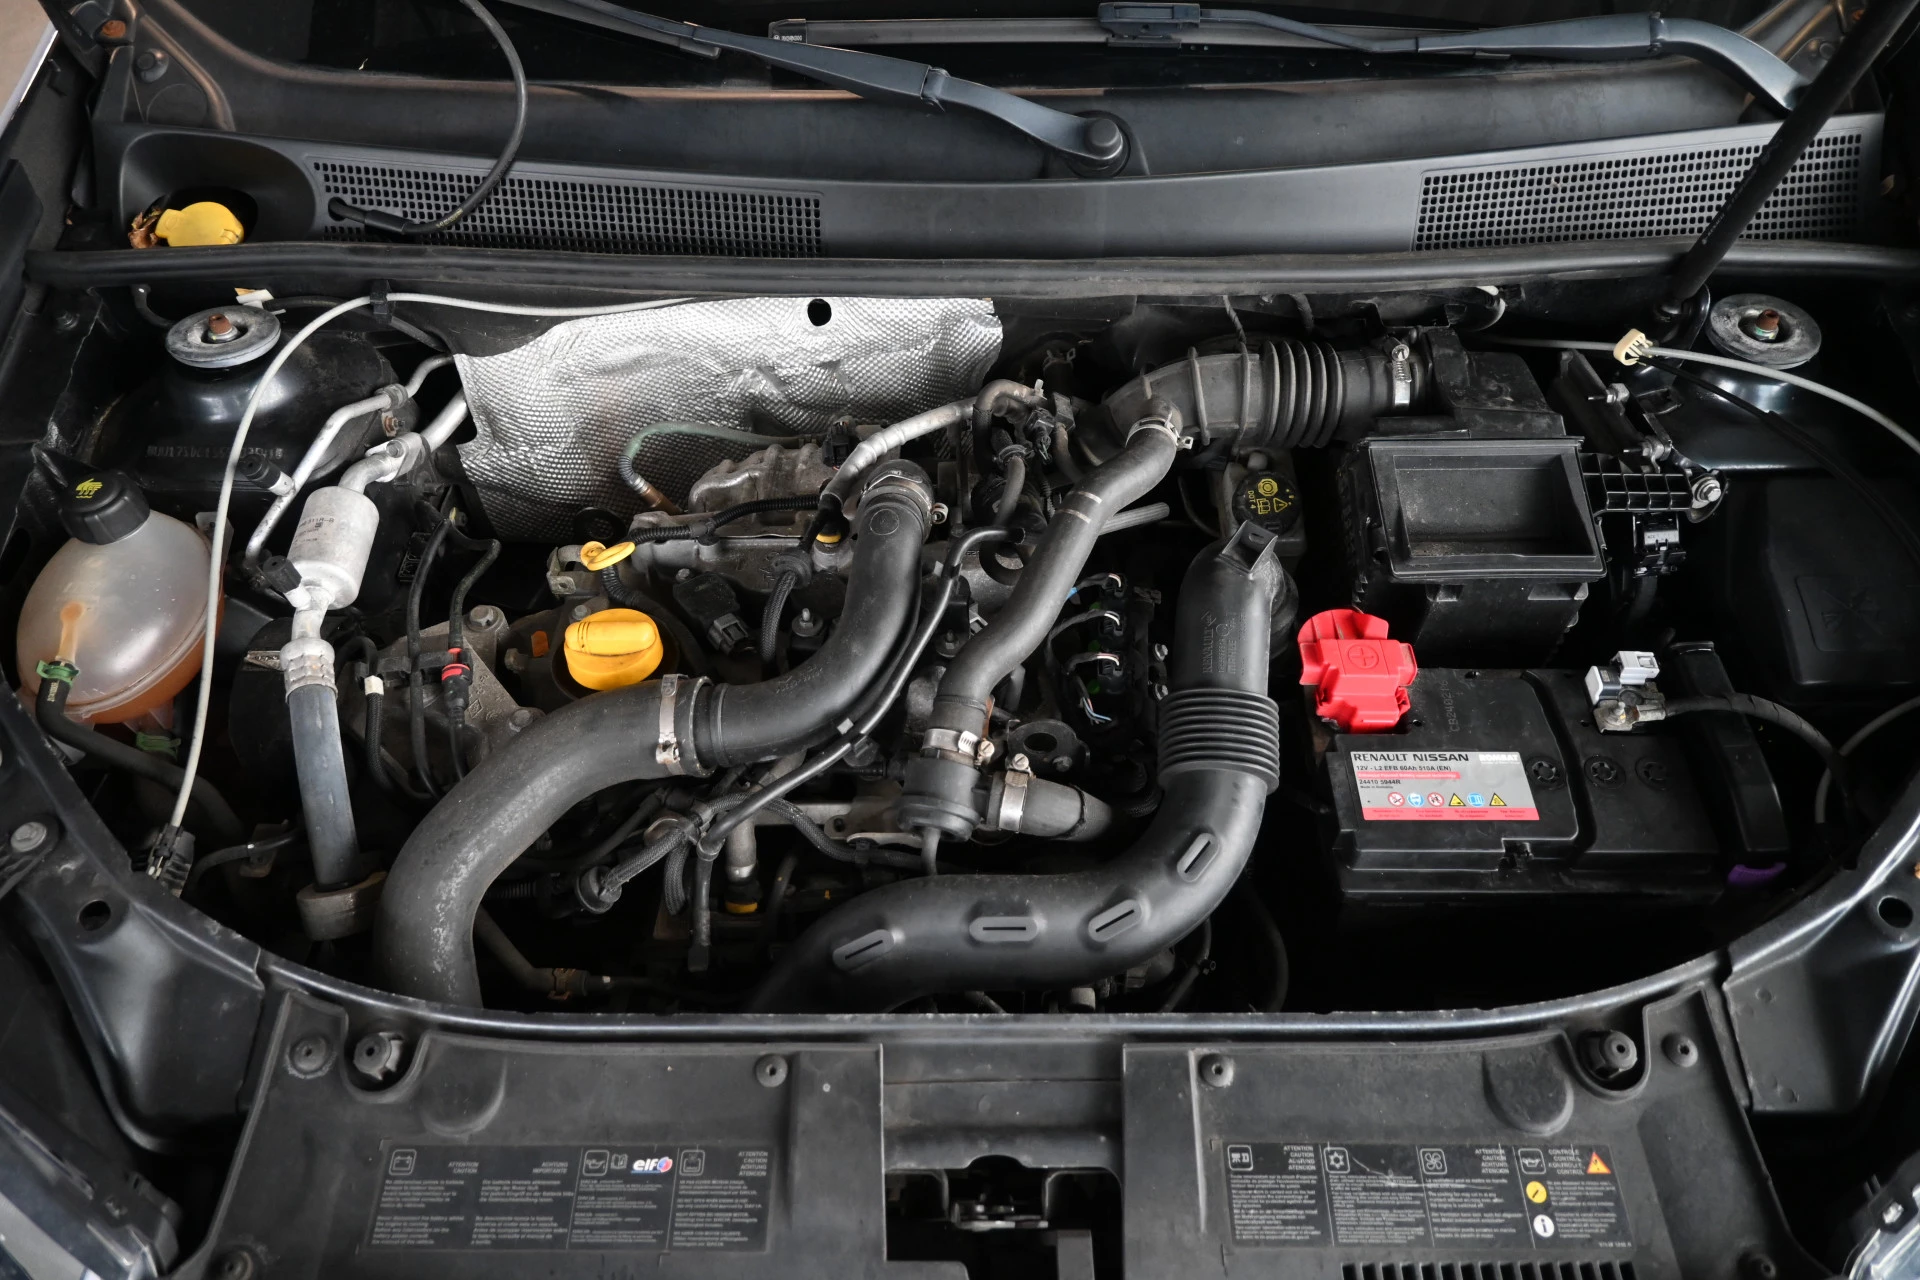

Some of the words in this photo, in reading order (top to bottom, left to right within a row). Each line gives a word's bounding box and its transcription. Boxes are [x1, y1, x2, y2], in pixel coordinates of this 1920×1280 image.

[1247, 490, 1256, 503] DOT
[1353, 753, 1408, 762] RENAULT
[1413, 753, 1469, 762] NISSAN
[633, 1158, 659, 1171] elf
